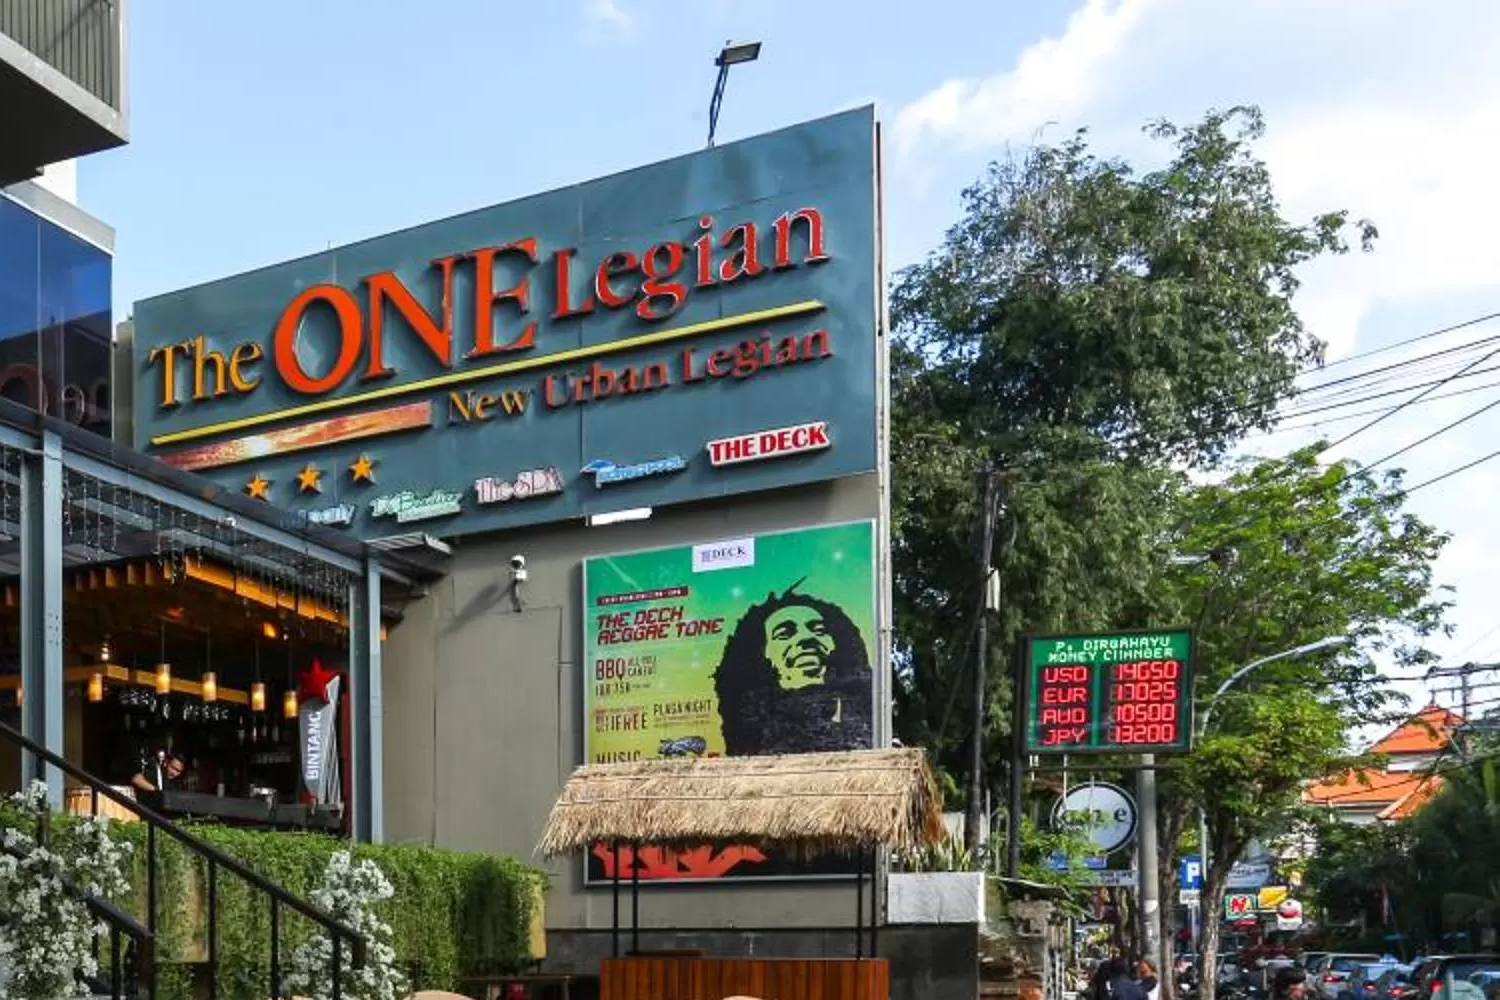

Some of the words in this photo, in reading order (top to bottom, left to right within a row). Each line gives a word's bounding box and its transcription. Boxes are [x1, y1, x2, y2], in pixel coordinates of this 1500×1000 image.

[147, 336, 263, 409] The
[273, 237, 538, 395] ONE
[549, 207, 832, 321] Legian
[448, 385, 532, 424] New
[543, 361, 669, 409] Urban
[681, 327, 834, 379] Legian
[710, 438, 756, 462] THE
[759, 425, 828, 455] DECK
[597, 611, 631, 630] THE
[598, 623, 671, 646] REGGAE
[675, 617, 725, 638] TONE
[1048, 650, 1098, 663] MONEY
[1103, 647, 1174, 661] CHANGER
[596, 657, 626, 681] BBQ
[1044, 666, 1088, 684] USD
[1117, 660, 1179, 681] 14650
[1043, 687, 1088, 704] EUR
[1117, 682, 1177, 702] 17025
[1043, 708, 1086, 725] AUD
[1117, 703, 1176, 723] 10500
[306, 711, 322, 781] BINTANG
[1043, 728, 1086, 745] JPY
[1115, 723, 1175, 744] 13200
